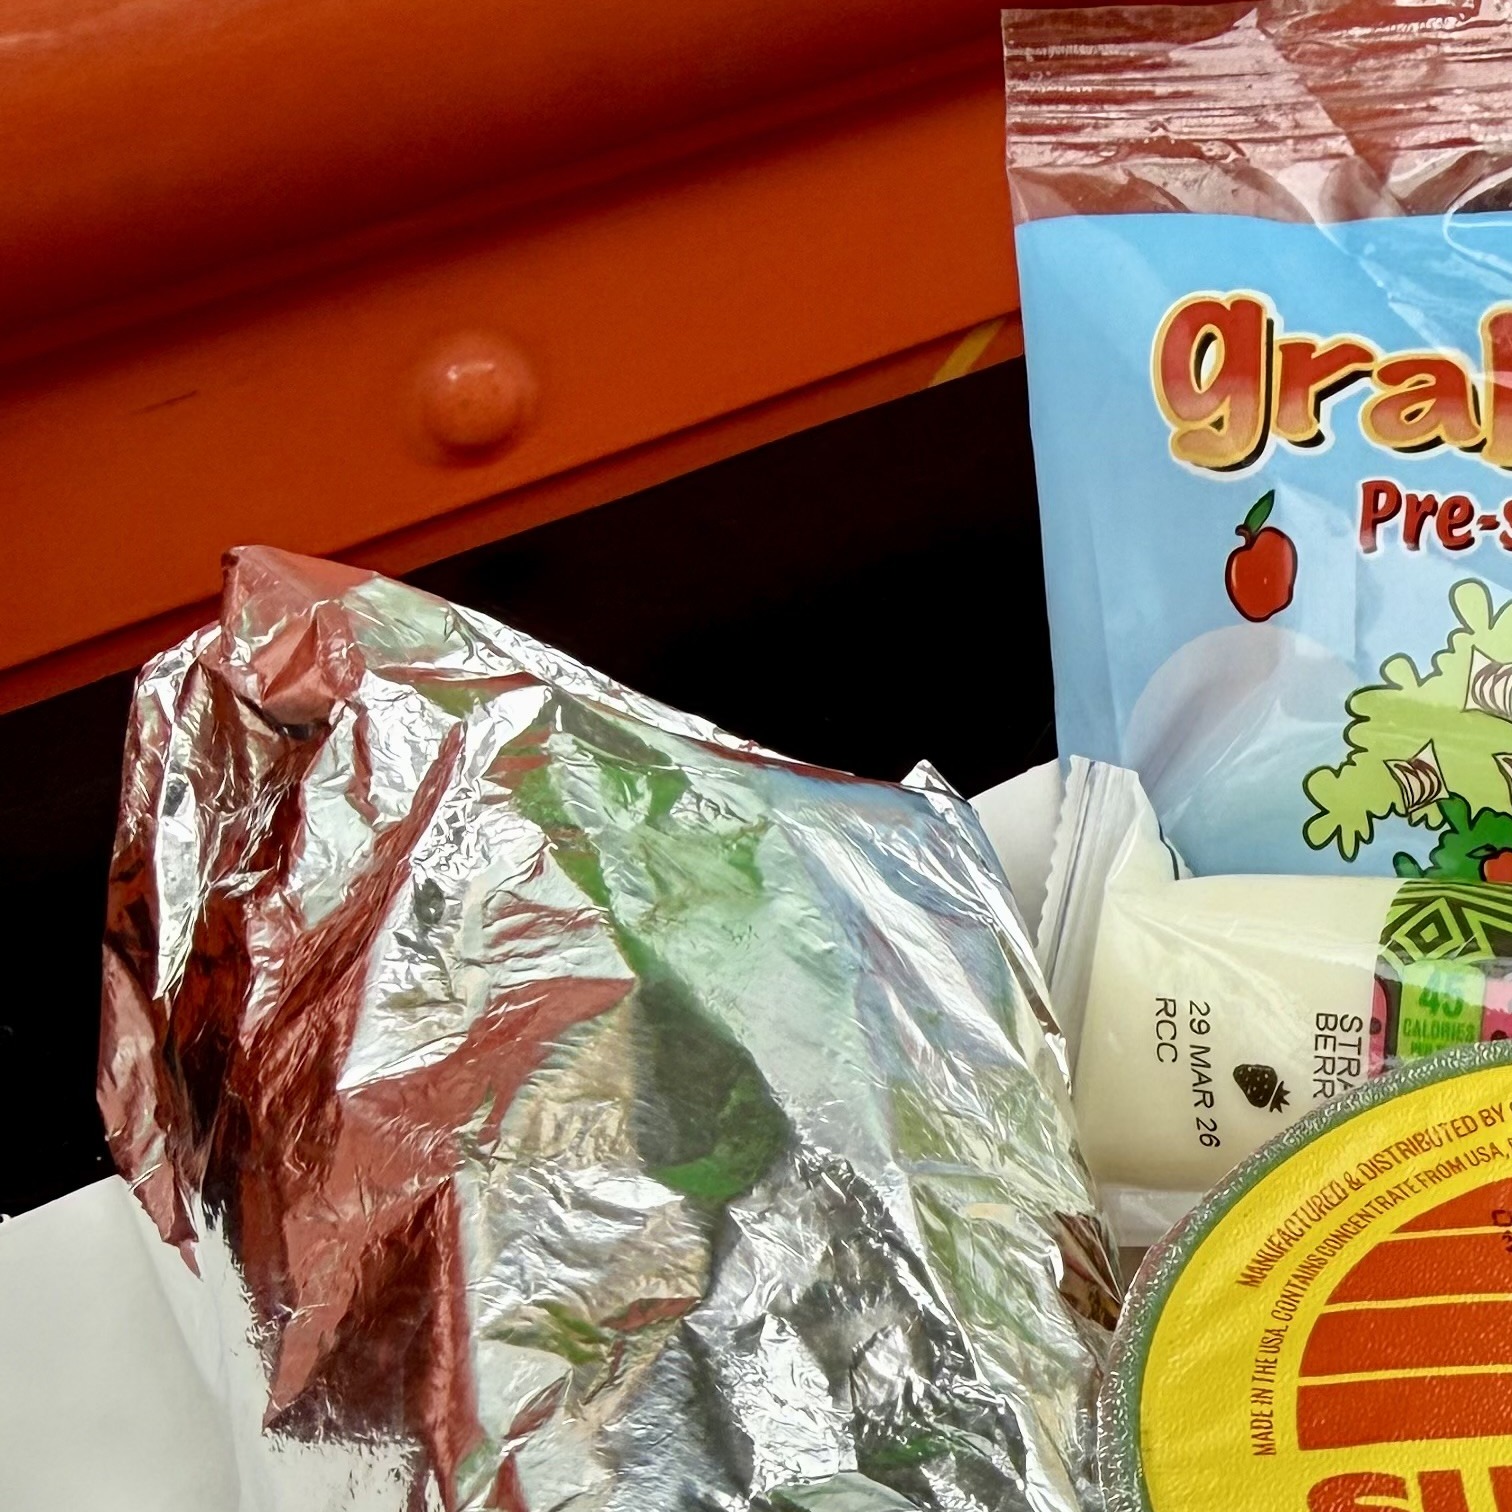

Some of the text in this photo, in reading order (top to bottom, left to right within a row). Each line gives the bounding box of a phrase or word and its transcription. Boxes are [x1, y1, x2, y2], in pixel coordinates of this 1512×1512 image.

[1155, 996, 1179, 1064] RCC
[1188, 1000, 1221, 1149] 29 MAR 26
[1477, 1102, 1506, 1128] BY
[1355, 1115, 1479, 1182] DISTRIBUTED
[1414, 1155, 1468, 1194] FROM
[1347, 1170, 1364, 1192] &
[1236, 1179, 1350, 1288] MANUFACTURED
[1315, 1175, 1420, 1260] CONCENTRATE
[1271, 1252, 1329, 1323] CONTAINS
[1250, 1386, 1275, 1404] IN
[1251, 1357, 1278, 1384] THE
[1252, 1408, 1277, 1456] MADE
